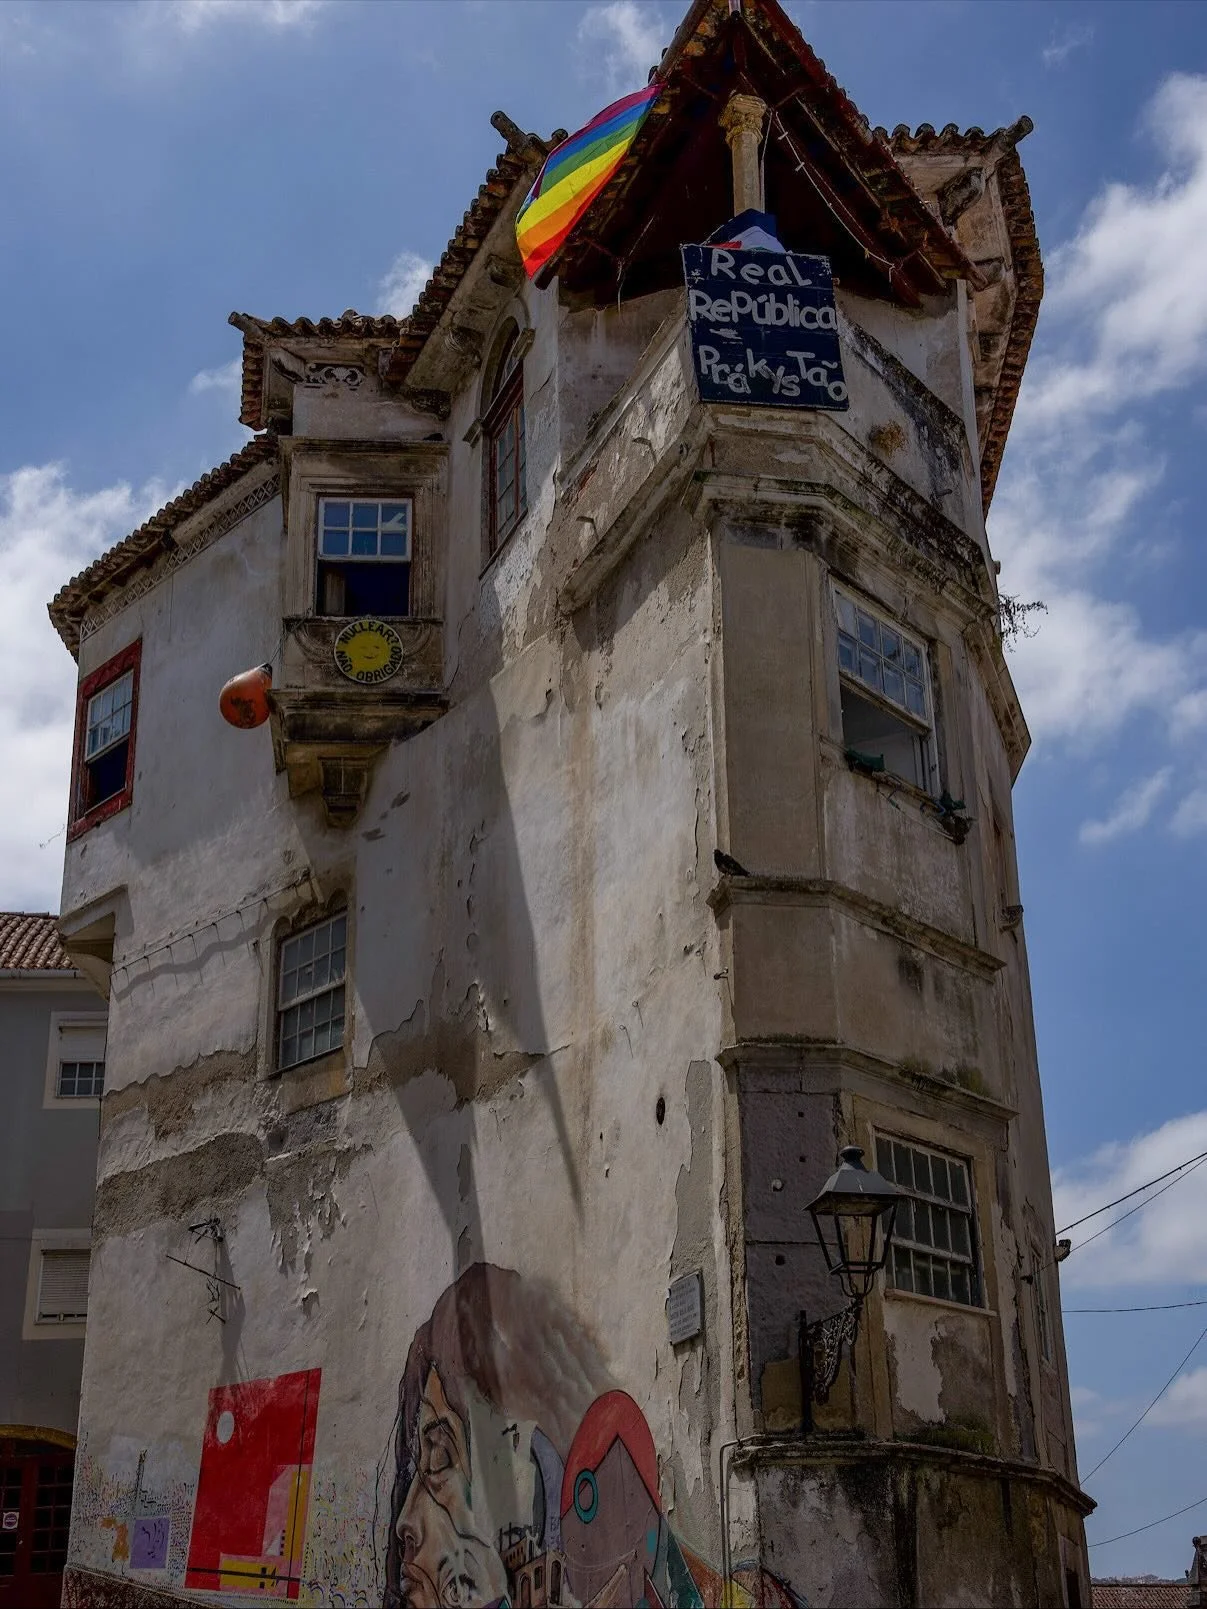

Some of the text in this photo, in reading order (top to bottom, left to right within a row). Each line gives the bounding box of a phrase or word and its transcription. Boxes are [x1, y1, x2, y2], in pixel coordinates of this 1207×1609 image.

[339, 621, 400, 645] NUCLEAR?
[336, 646, 403, 682] NÃO OBRIGADO
